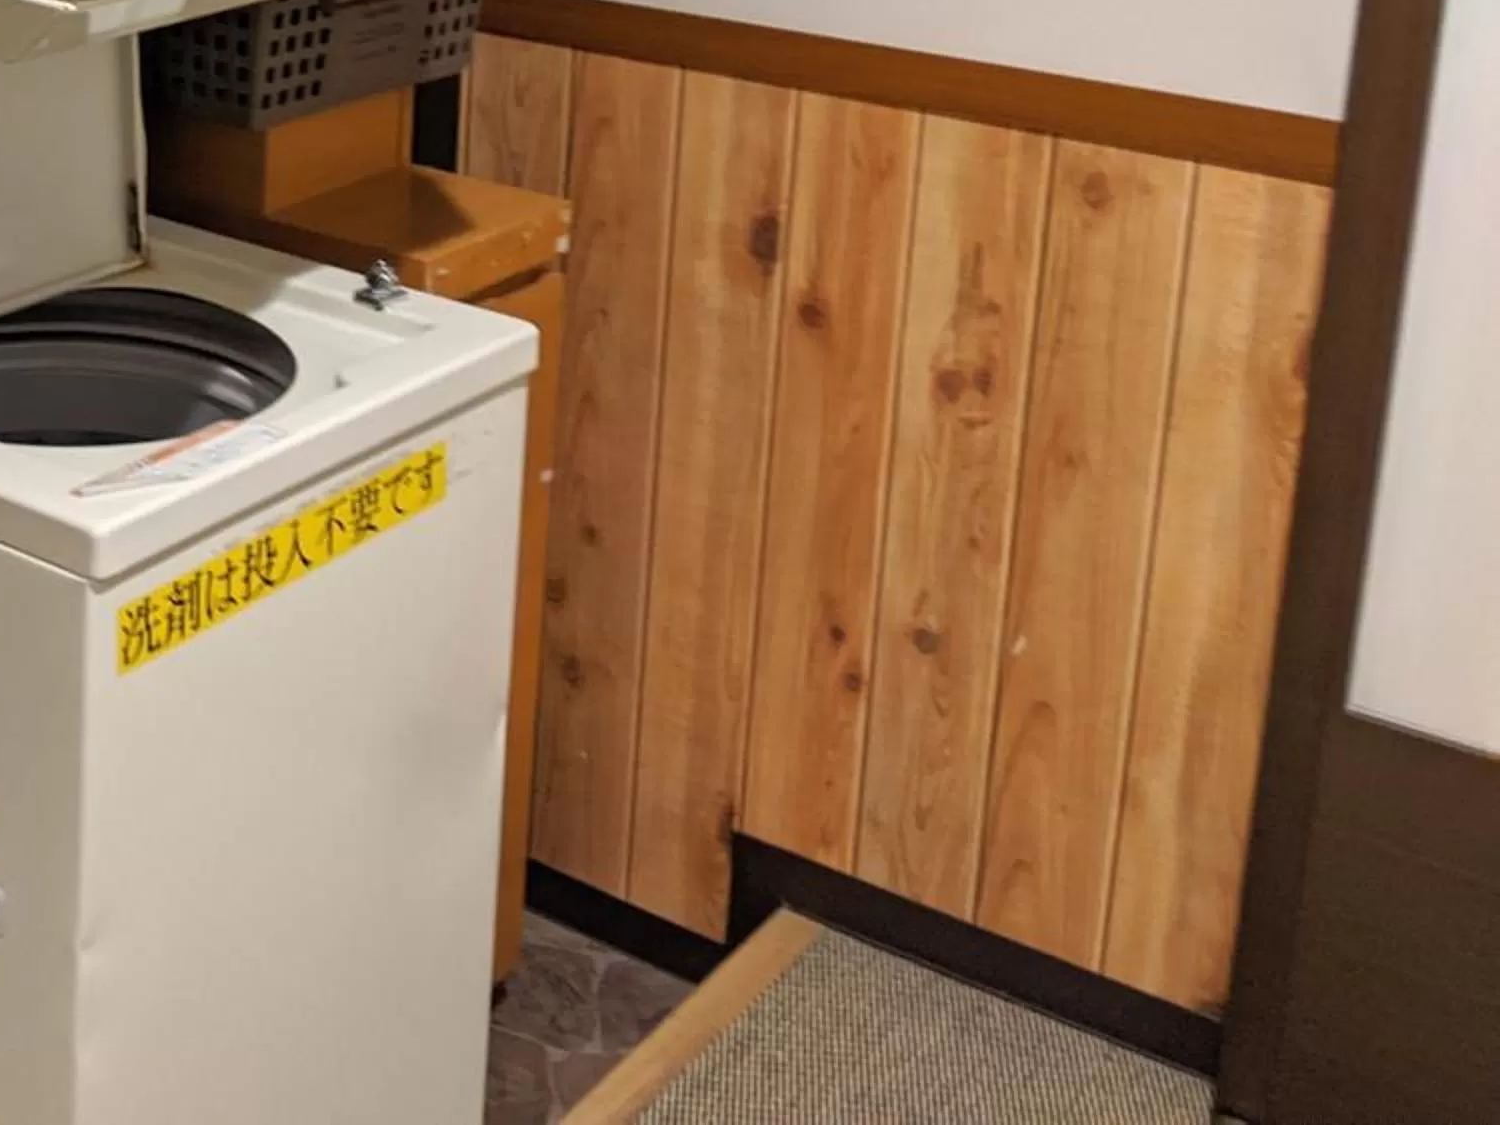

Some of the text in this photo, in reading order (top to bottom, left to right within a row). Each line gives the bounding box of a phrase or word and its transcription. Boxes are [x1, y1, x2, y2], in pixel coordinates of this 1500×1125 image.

[120, 449, 444, 667] 洗剤は投入不要です
